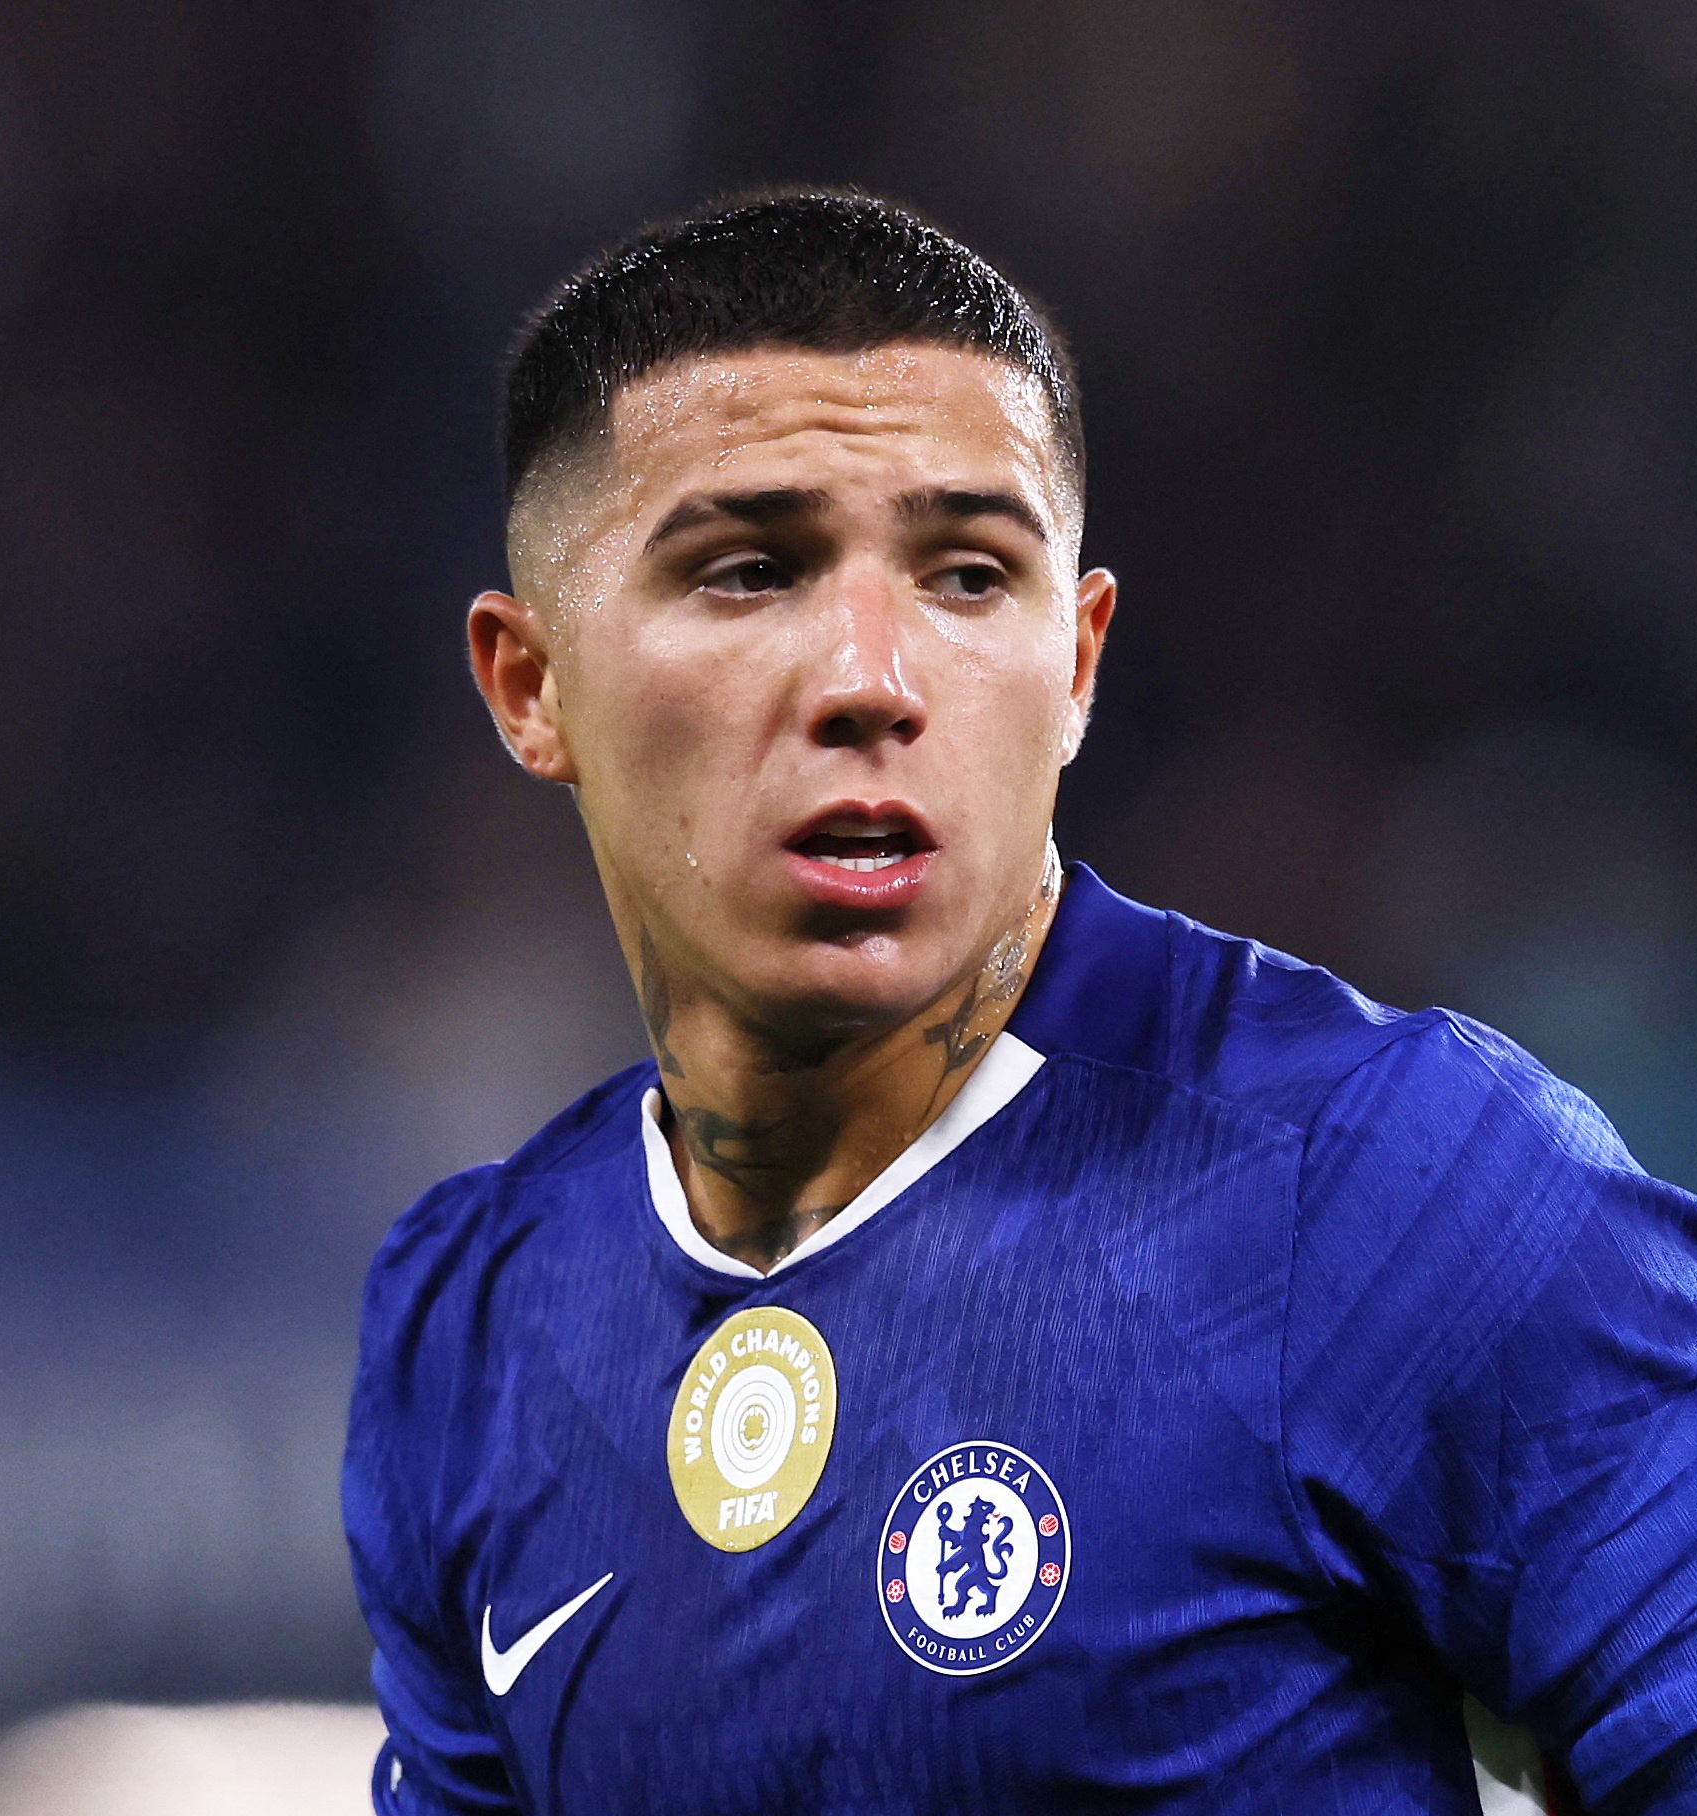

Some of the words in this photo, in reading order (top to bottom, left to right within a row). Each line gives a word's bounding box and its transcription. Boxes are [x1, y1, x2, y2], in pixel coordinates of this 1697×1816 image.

[683, 1351, 728, 1465] WORLD
[730, 1327, 822, 1445] CHAMPIONS
[913, 1450, 1032, 1504] CHELSEA
[718, 1490, 780, 1531] FIFA
[907, 1626, 987, 1662] FOOTBALL
[994, 1613, 1036, 1652] CLUB
